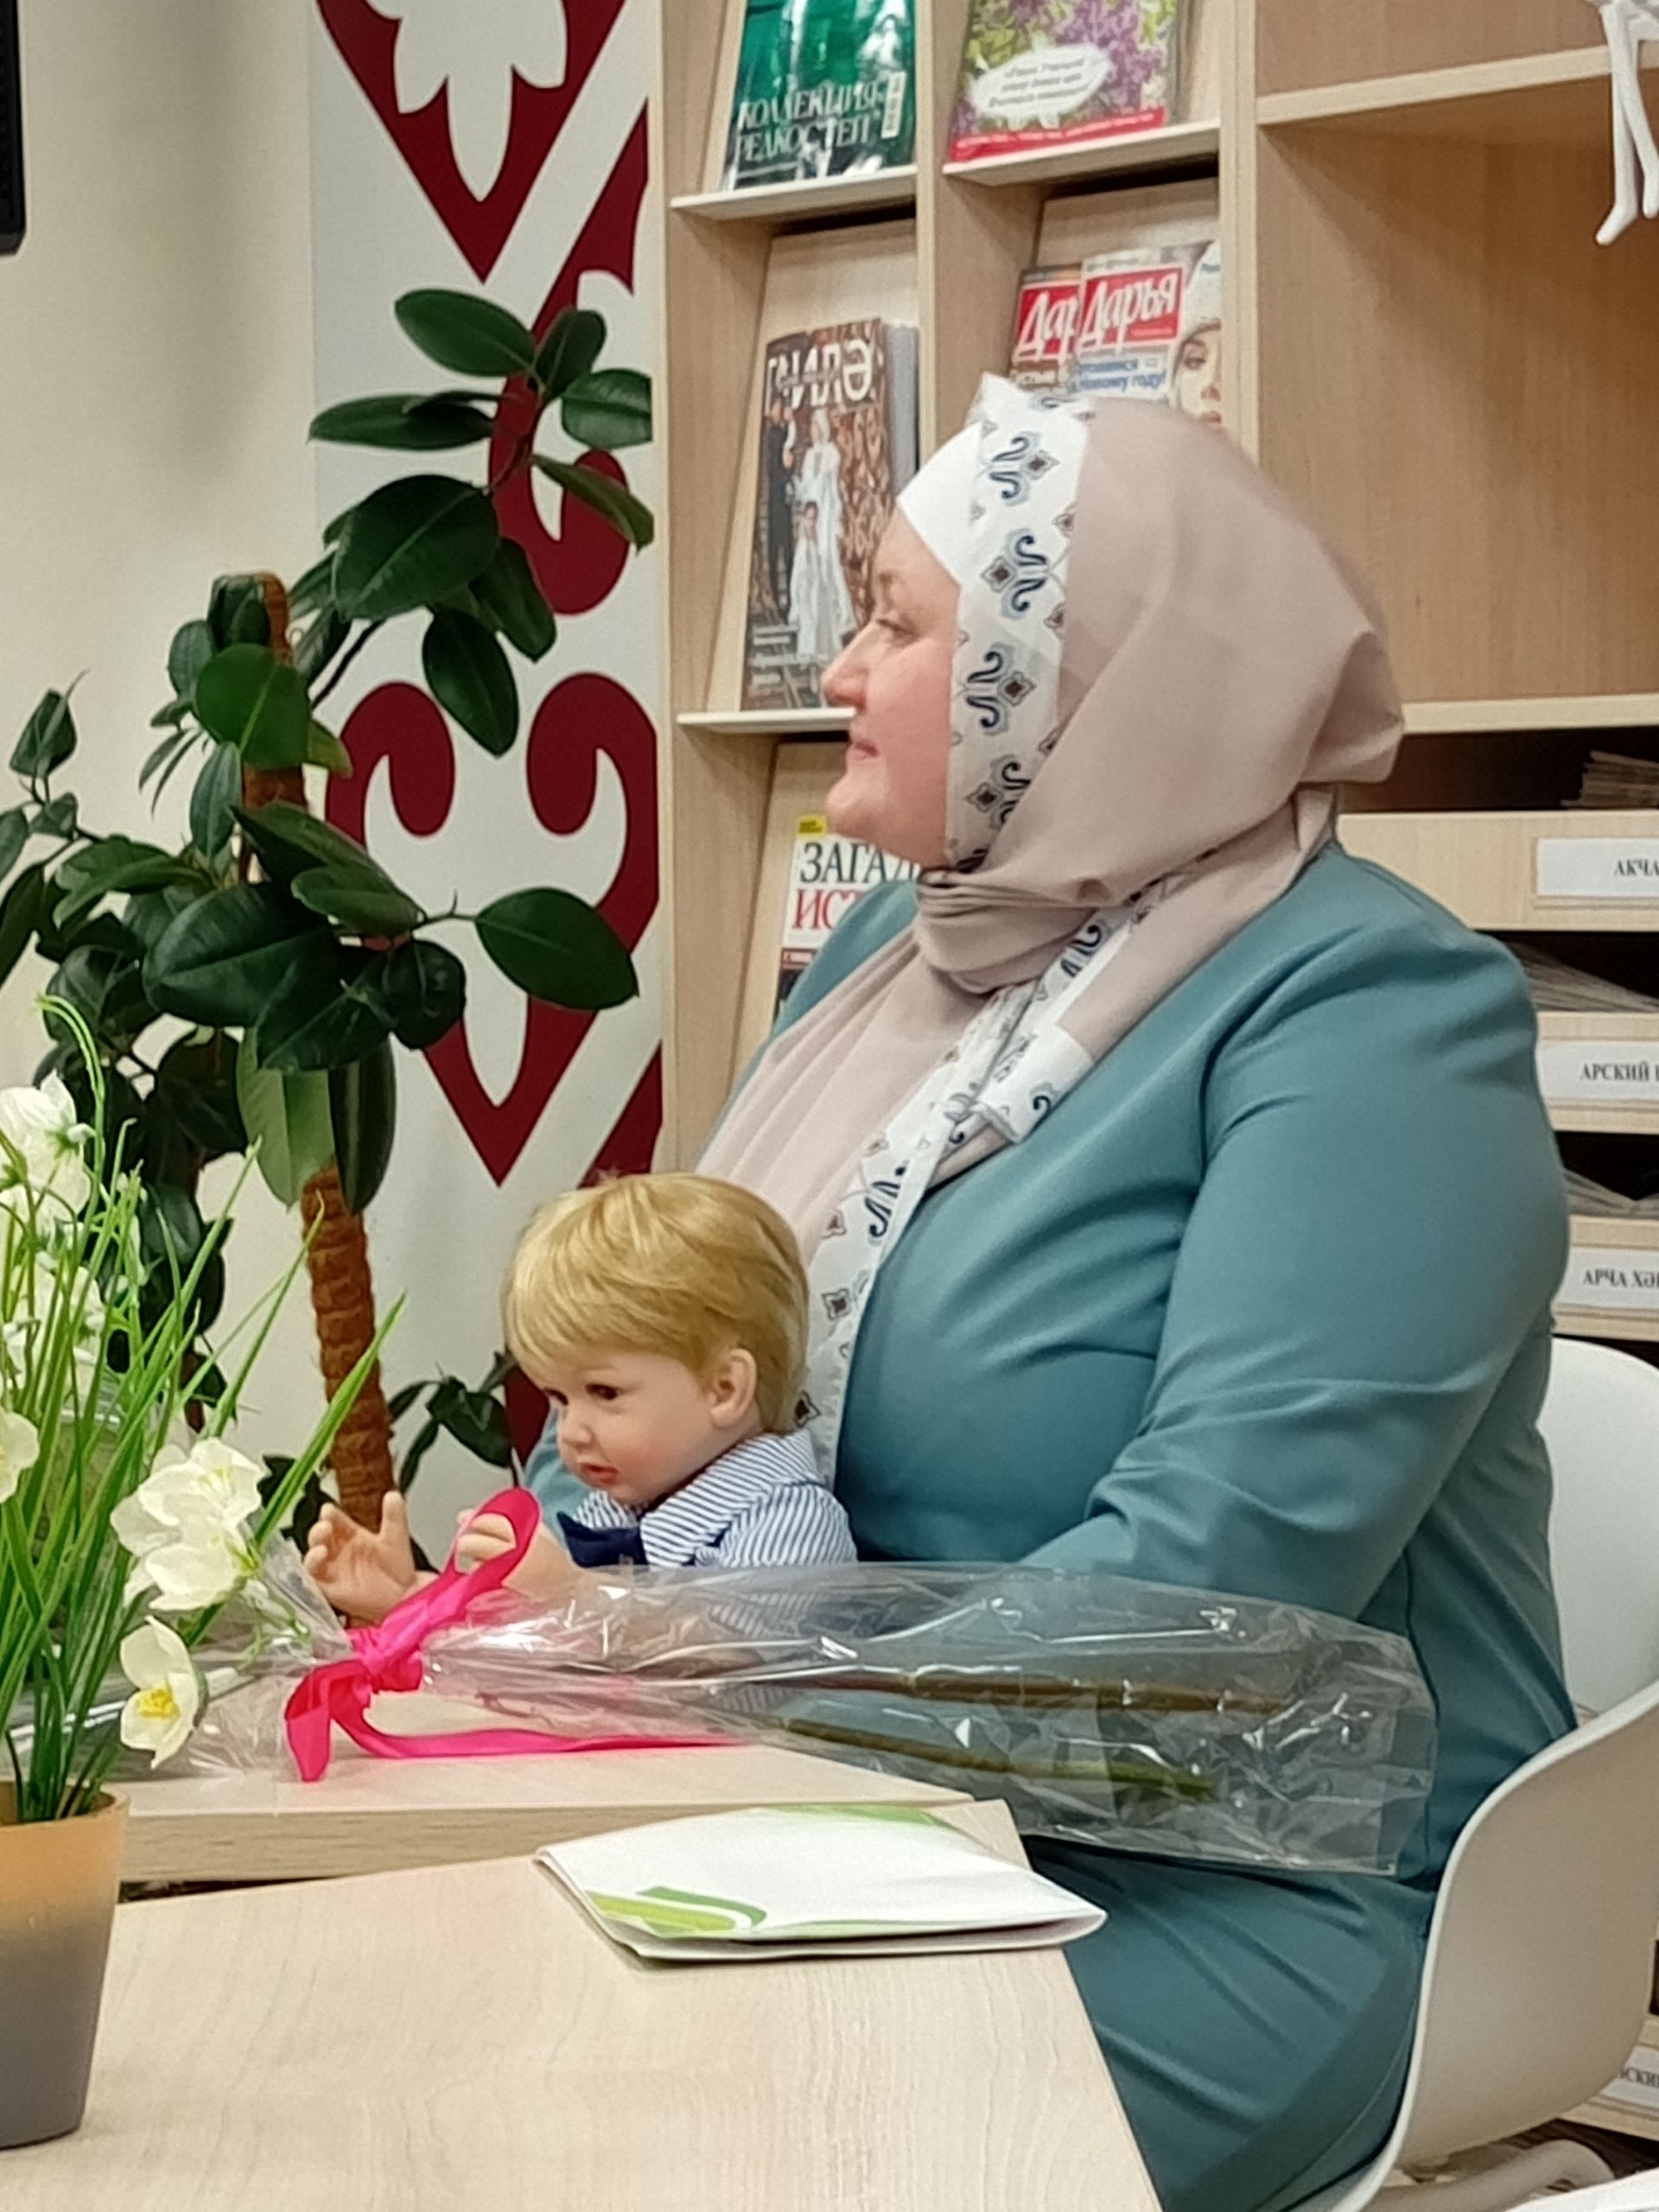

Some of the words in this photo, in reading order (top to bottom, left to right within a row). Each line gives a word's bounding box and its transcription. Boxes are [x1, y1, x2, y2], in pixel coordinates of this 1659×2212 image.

[1080, 273, 1178, 354] Дарья
[1580, 1061, 1649, 1081] АРСКИЙ
[1583, 1268, 1627, 1287] АРЧА
